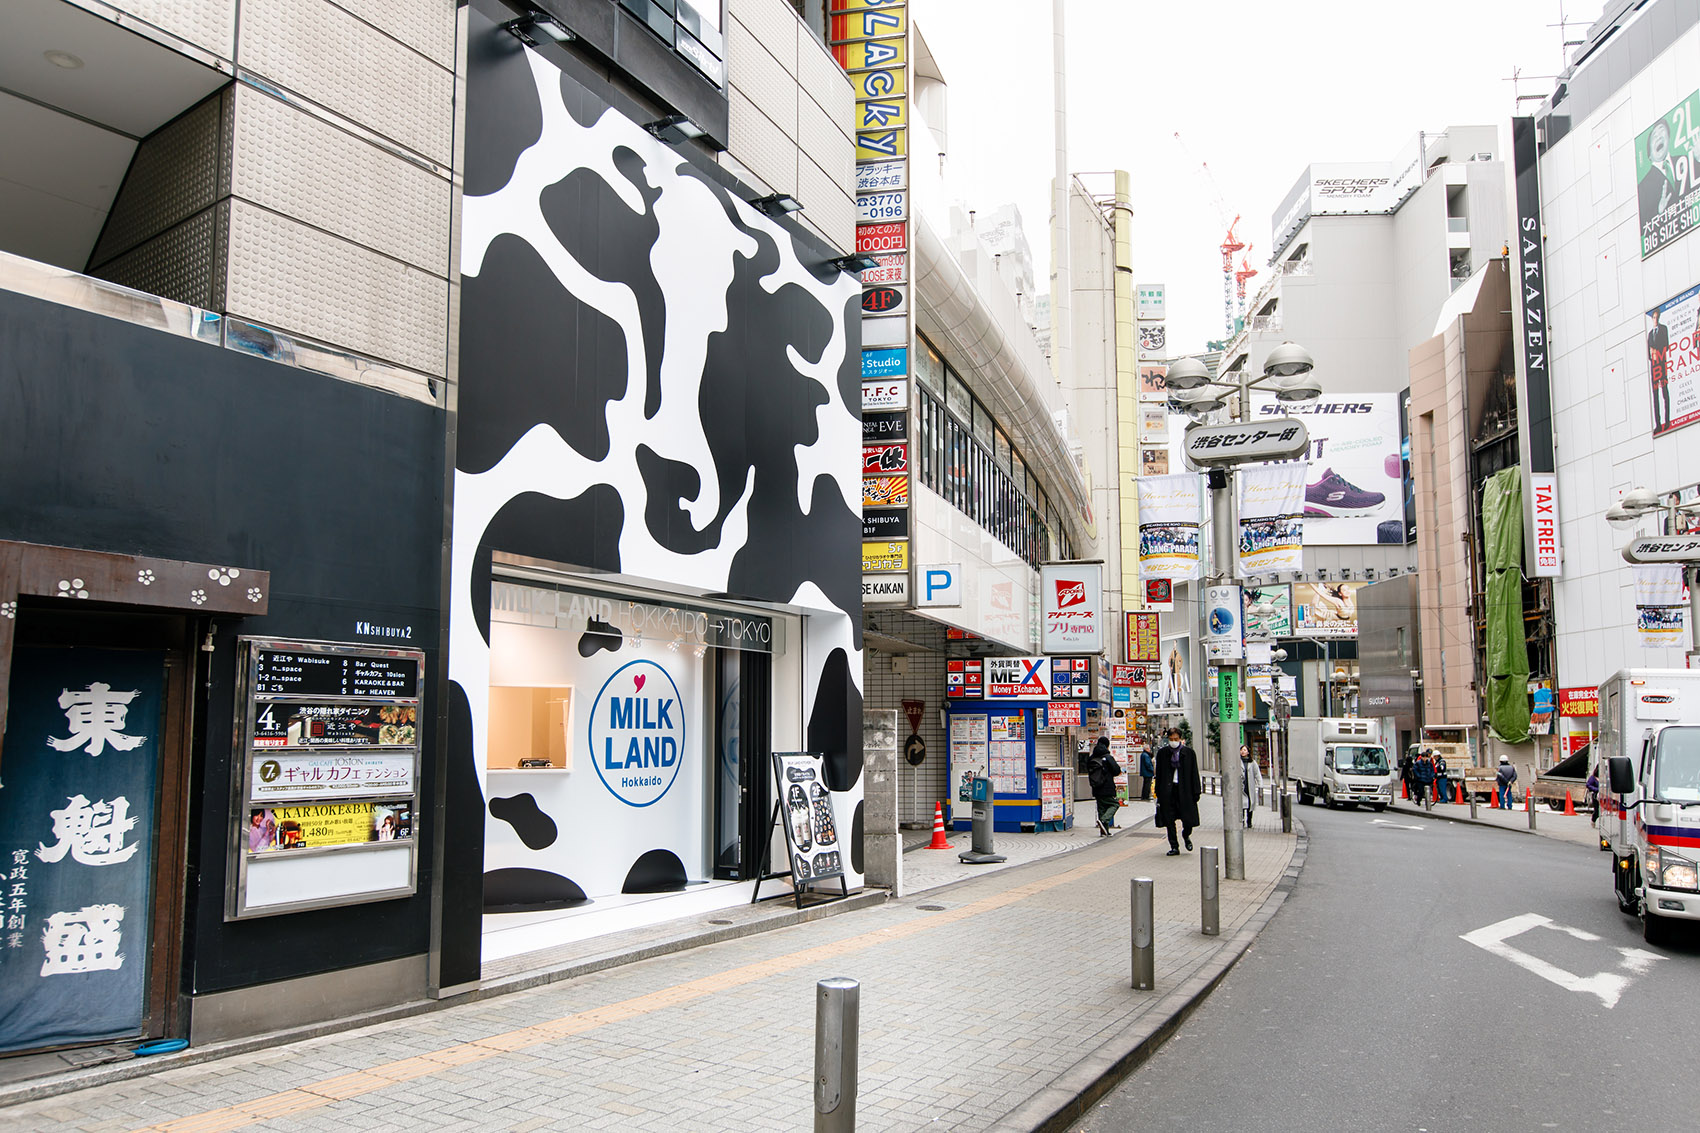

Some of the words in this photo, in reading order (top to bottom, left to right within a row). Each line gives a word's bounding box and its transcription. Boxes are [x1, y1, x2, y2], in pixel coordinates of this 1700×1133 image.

[1673, 100, 1699, 149] 2L
[856, 163, 903, 177] ブラッキー
[858, 175, 901, 188] 渋谷本店
[1314, 178, 1390, 186] SKECHERS
[1319, 186, 1379, 194] SPORT
[869, 194, 902, 207] 3770
[863, 206, 902, 218] -0196
[858, 224, 901, 235] 初めての方
[1644, 232, 1659, 254] BIG
[1659, 218, 1680, 244] SIZE
[857, 236, 903, 251] 1000円
[885, 268, 903, 282] 深夜
[1522, 216, 1544, 371] SAKAZEN
[863, 290, 894, 310] 4F
[867, 357, 901, 368] Studio
[862, 386, 898, 397] T.F.C
[879, 421, 904, 432] EVE
[1190, 427, 1299, 450] 渋谷センター街
[1536, 485, 1553, 514] TAX
[1273, 535, 1302, 546] PARADE
[1537, 519, 1555, 554] FREE
[888, 543, 902, 553] 5F
[1149, 544, 1170, 554] GANG
[1171, 544, 1198, 555] PARADE
[862, 559, 903, 570] ワンカラ
[873, 582, 904, 594] KAIKAN
[926, 570, 952, 601] P
[491, 581, 548, 614] MILK
[555, 596, 613, 623] LAND
[619, 603, 707, 637] HOKKAIDO
[724, 616, 771, 644] TOKYO
[1048, 611, 1094, 619] アドアーズ
[297, 656, 330, 665] Wabisuke
[343, 659, 348, 667] 8
[371, 661, 389, 669] Quest
[990, 660, 1020, 668] 外貨両替
[258, 674, 270, 682] 1-2
[343, 668, 348, 676] 7
[355, 669, 383, 677] ギャルカフェ
[370, 688, 395, 696] HEAVEN
[993, 685, 1012, 695] Money
[1013, 685, 1043, 694] EXchange
[1152, 691, 1161, 703] P
[257, 704, 281, 732] 4F
[611, 697, 675, 729] MILK
[605, 736, 678, 770] LAND
[284, 767, 324, 782] ギャル
[327, 767, 361, 781] カフェ
[366, 767, 409, 779] テンション
[622, 776, 663, 788] Hokkaido
[976, 781, 983, 798] P
[7, 848, 30, 949] 寛政五年創業
